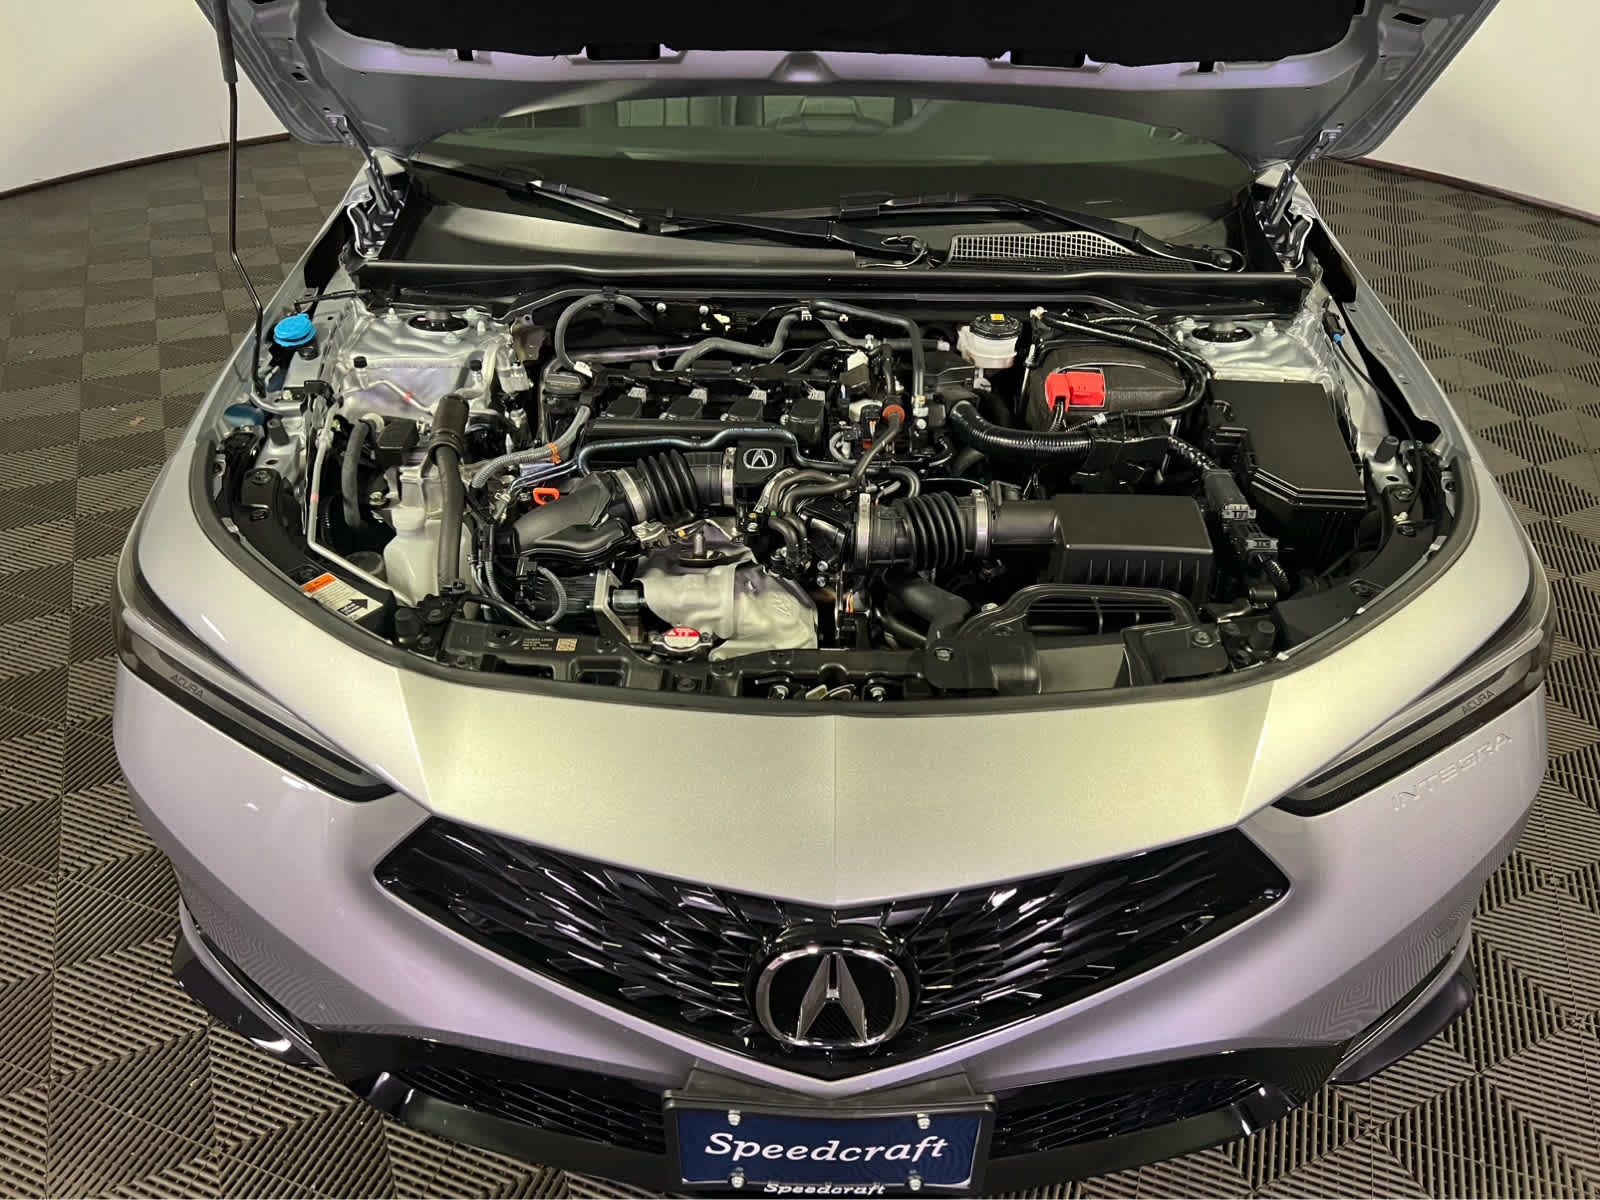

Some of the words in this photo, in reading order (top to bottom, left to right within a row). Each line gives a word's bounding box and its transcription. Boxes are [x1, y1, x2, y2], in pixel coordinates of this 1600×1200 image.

[1460, 689, 1496, 715] ACURA
[1391, 730, 1513, 812] INTEGRA
[704, 1132, 949, 1162] Speedcraft
[763, 1182, 887, 1196] Speedcraft
